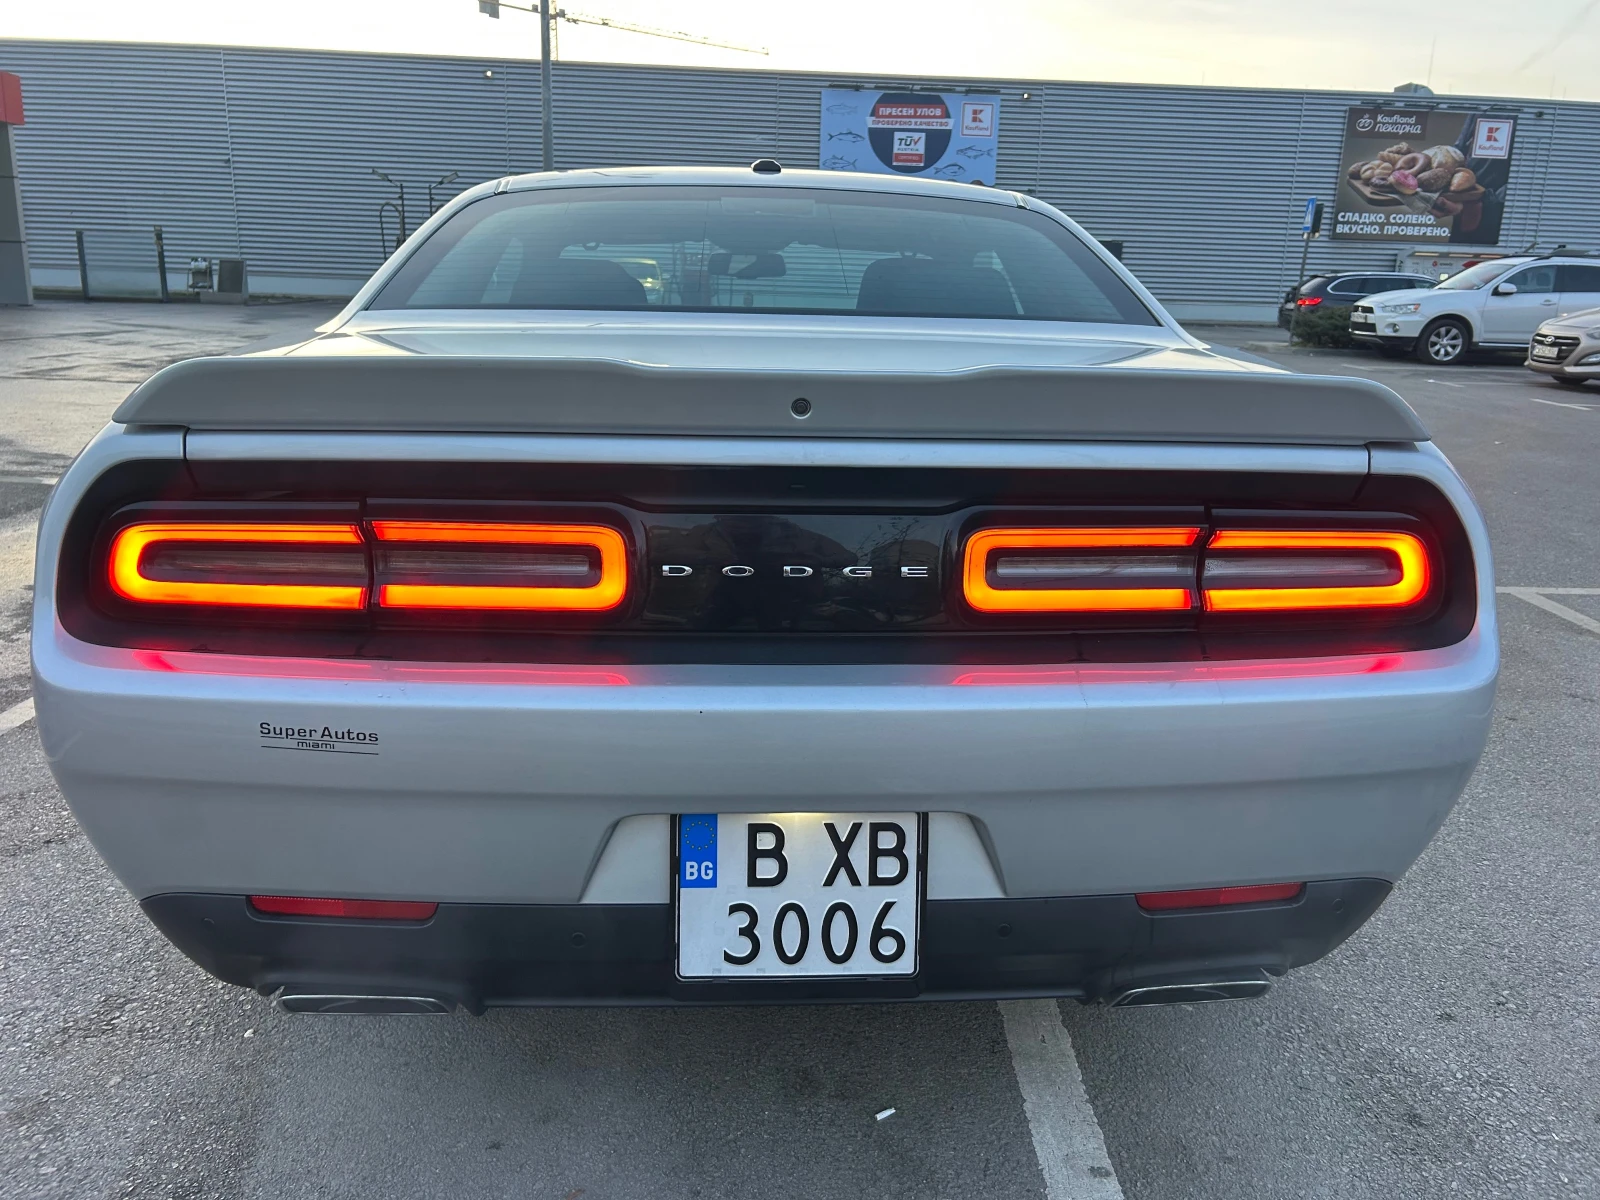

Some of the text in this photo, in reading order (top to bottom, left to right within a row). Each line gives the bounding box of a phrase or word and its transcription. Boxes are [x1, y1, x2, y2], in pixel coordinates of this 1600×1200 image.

[879, 107, 942, 116] ПРЕСЕН УЛОВ
[1377, 113, 1416, 124] Kaufland
[1375, 123, 1422, 135] пекарна
[897, 136, 922, 147] TÜV
[1337, 212, 1436, 225] СЛАДКО. СОЛЕНО.
[1336, 224, 1451, 237] ВКУСНО. ПРОВЕРЕНО.
[662, 565, 929, 577] DODGE
[297, 741, 335, 749] miami
[747, 821, 909, 887] B XB
[685, 861, 714, 881] BG
[723, 900, 906, 965] 3006
